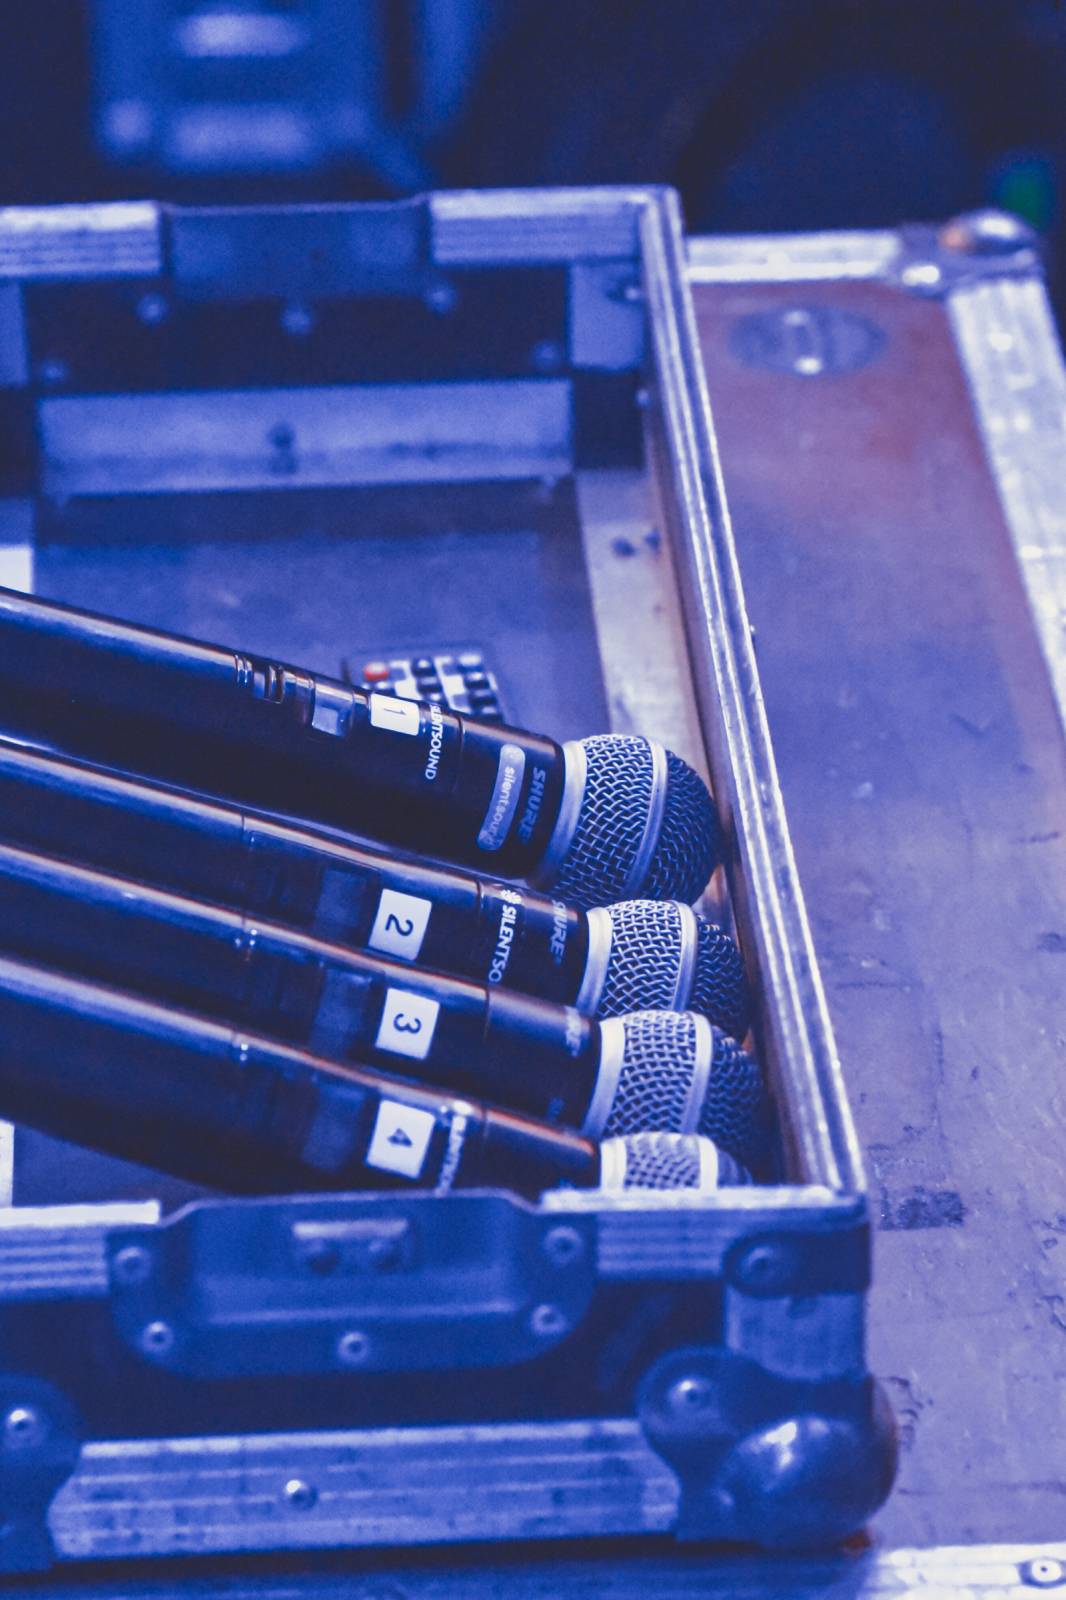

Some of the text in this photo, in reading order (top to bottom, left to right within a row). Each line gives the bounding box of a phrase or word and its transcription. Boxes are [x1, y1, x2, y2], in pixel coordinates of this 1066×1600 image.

[383, 706, 407, 717] 1
[385, 913, 414, 937] 2
[393, 1012, 422, 1035] 3
[387, 1127, 413, 1148] 4
